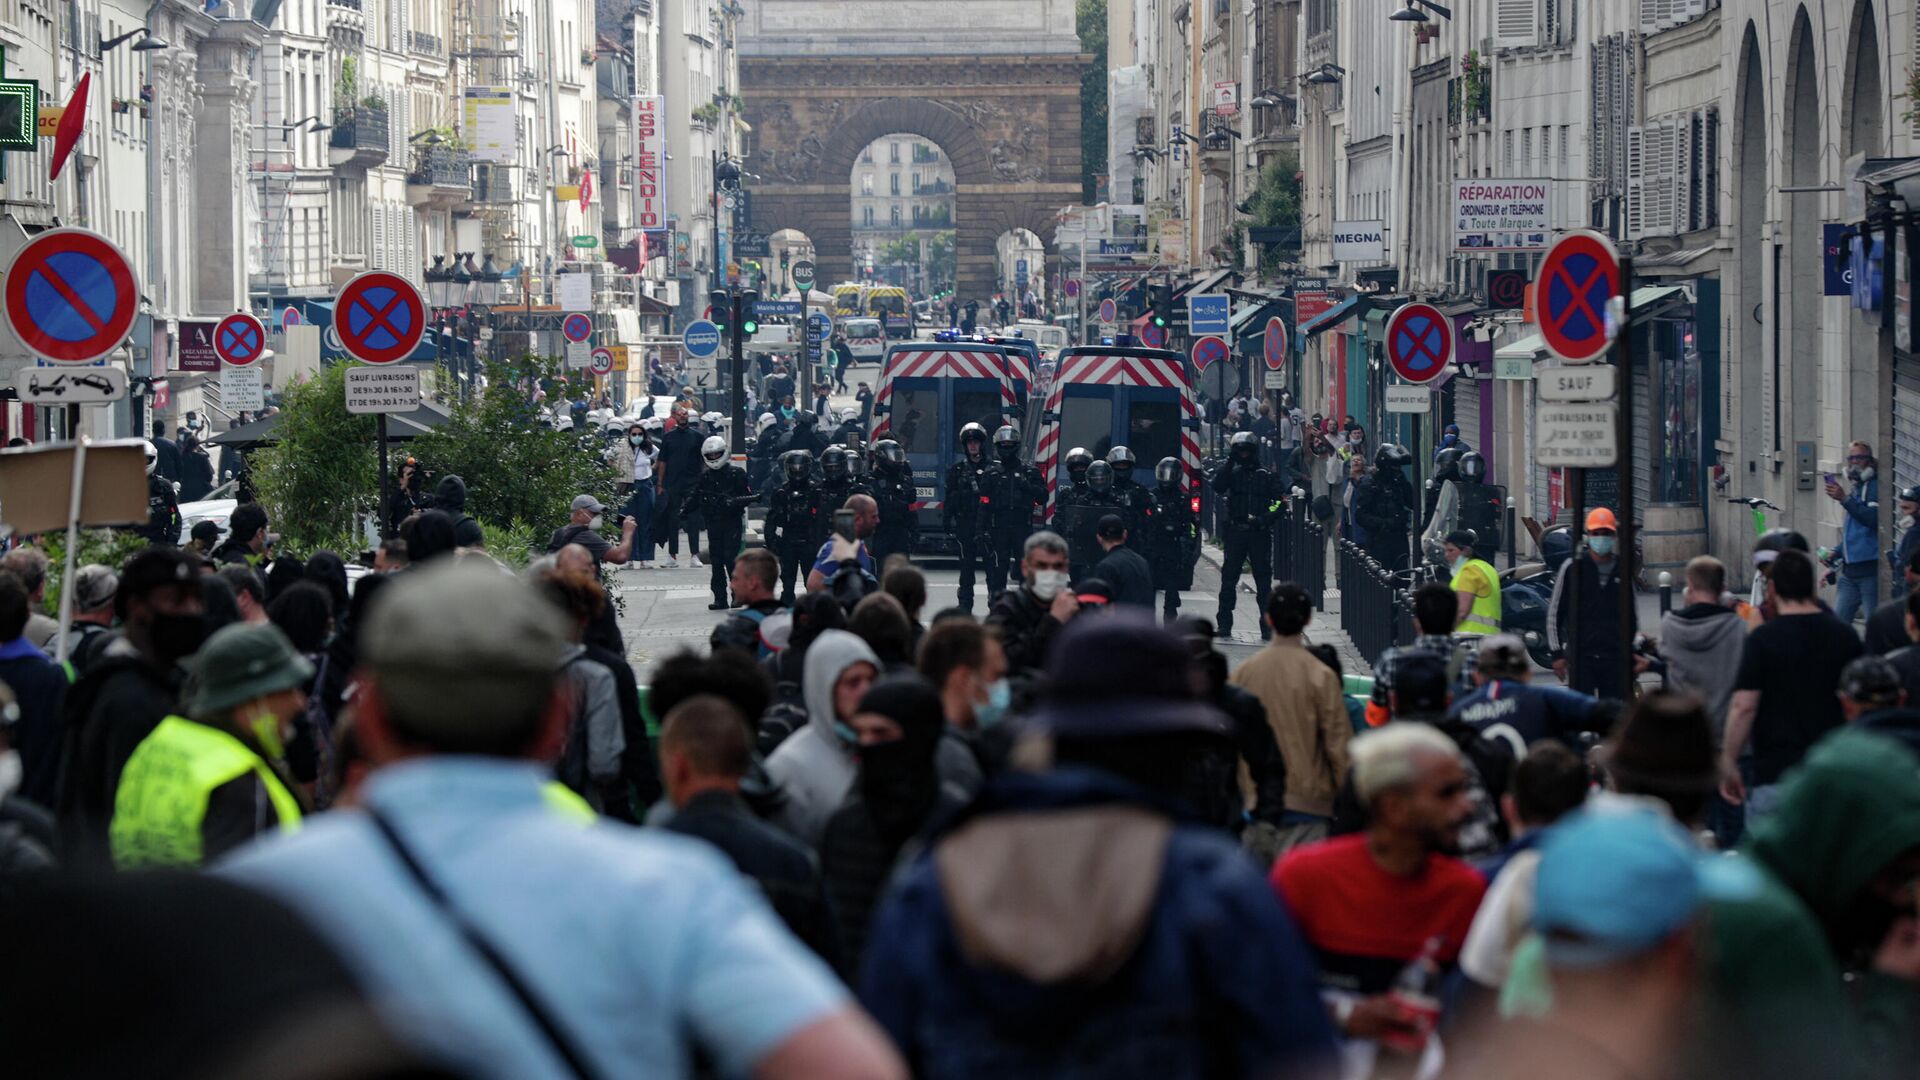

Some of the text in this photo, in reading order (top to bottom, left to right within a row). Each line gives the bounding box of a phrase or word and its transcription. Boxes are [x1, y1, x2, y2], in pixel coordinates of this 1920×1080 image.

[1459, 181, 1545, 200] RÉPARATION
[1460, 204, 1500, 216] ORDINATEUR
[1509, 200, 1544, 215] TÉLÉPHONE
[1471, 217, 1534, 230] Toute Marque
[1334, 233, 1382, 243] MEGNA
[1104, 246, 1129, 254] INDY
[795, 267, 814, 277] BUS
[1296, 280, 1322, 288] POMPES
[594, 356, 609, 368] 30
[349, 373, 416, 382] SAUF LIVRAISONS
[1558, 376, 1593, 390] SAUF
[353, 386, 362, 394] DE
[1543, 413, 1593, 422] LIVRAISON
